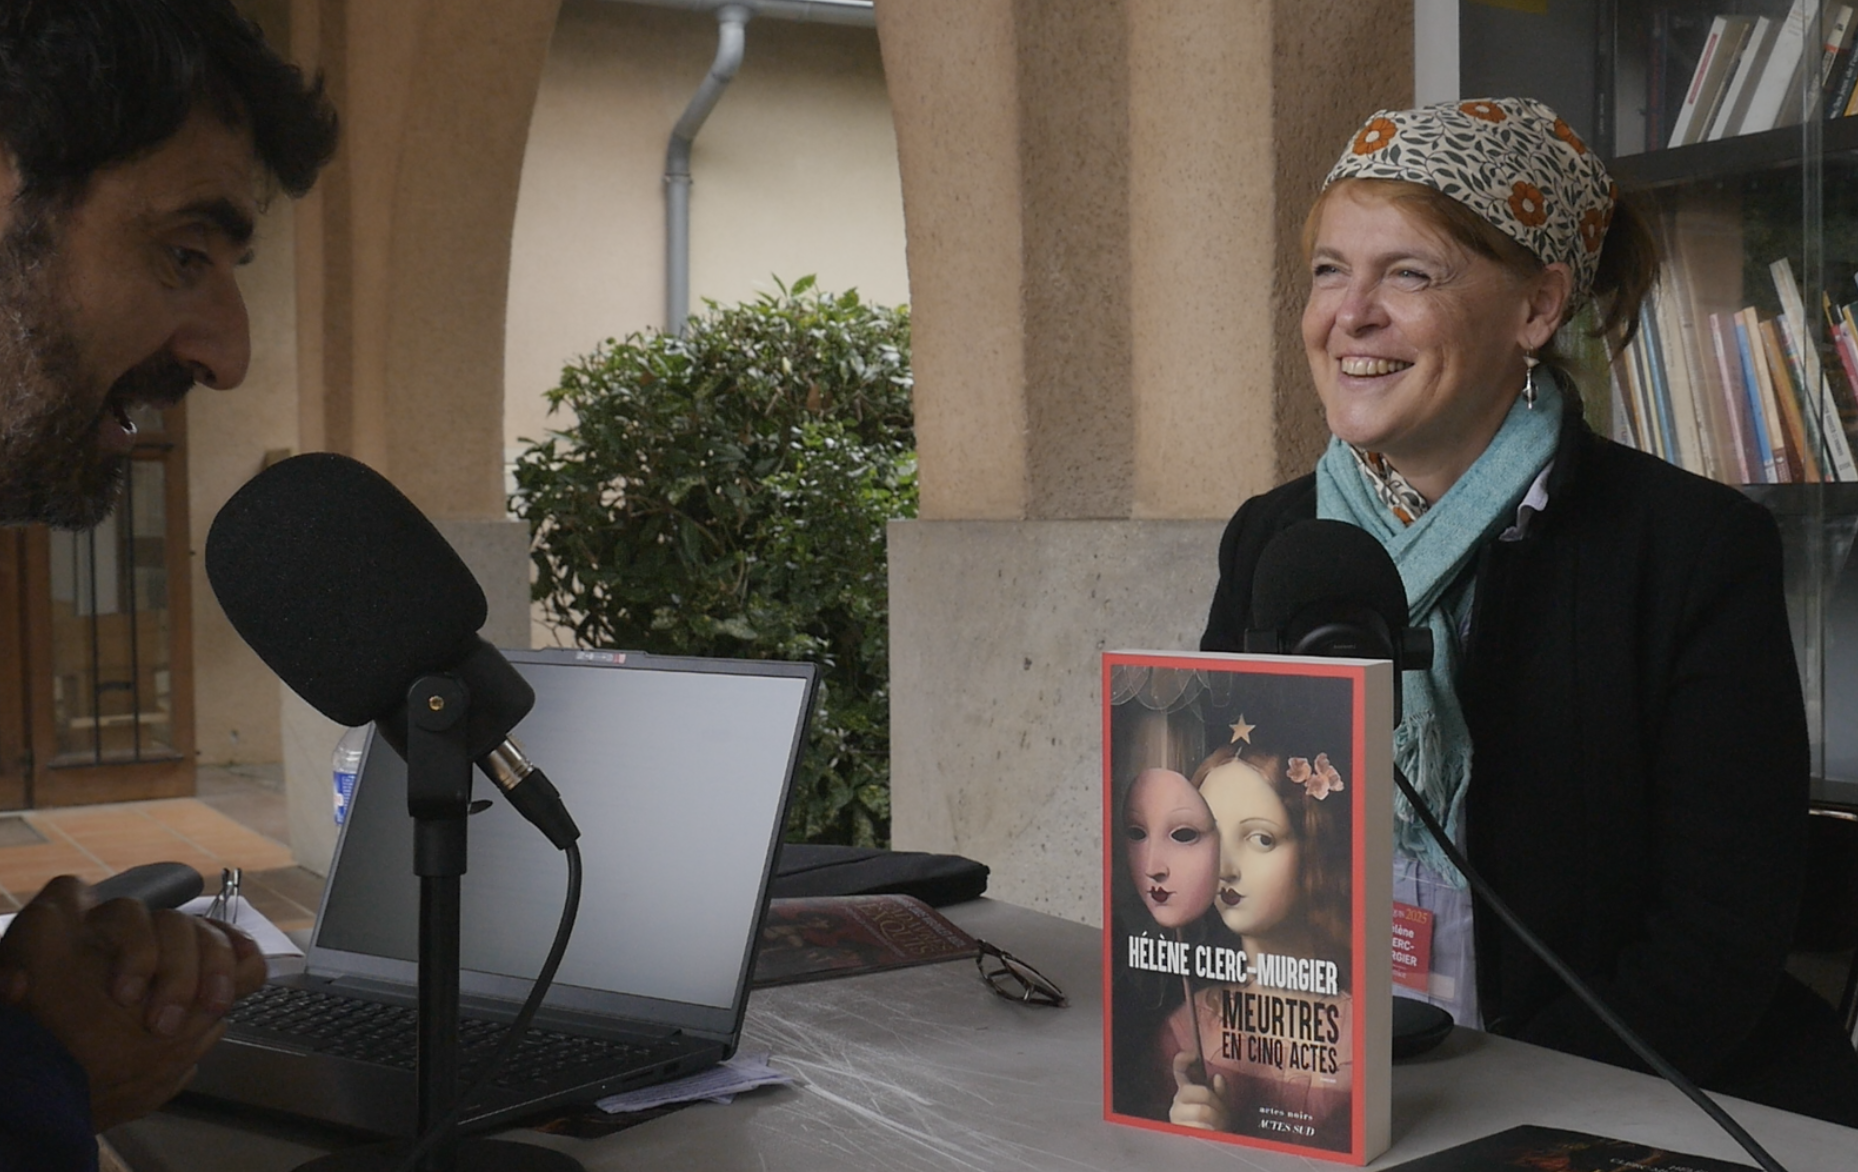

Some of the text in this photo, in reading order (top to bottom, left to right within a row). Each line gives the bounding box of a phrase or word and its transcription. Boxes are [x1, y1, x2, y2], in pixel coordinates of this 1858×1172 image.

[1405, 908, 1428, 925] 2025
[1392, 937, 1415, 951] ERC-
[1128, 931, 1338, 995] HÉLÈNE CLERC-MURGIER
[1392, 949, 1417, 967] RGIER
[1222, 990, 1339, 1044] MEURTRES
[1222, 1031, 1337, 1074] EN CINQ ACTES
[1287, 1111, 1313, 1121] noirs
[1258, 1119, 1315, 1137] ACTES SUD
